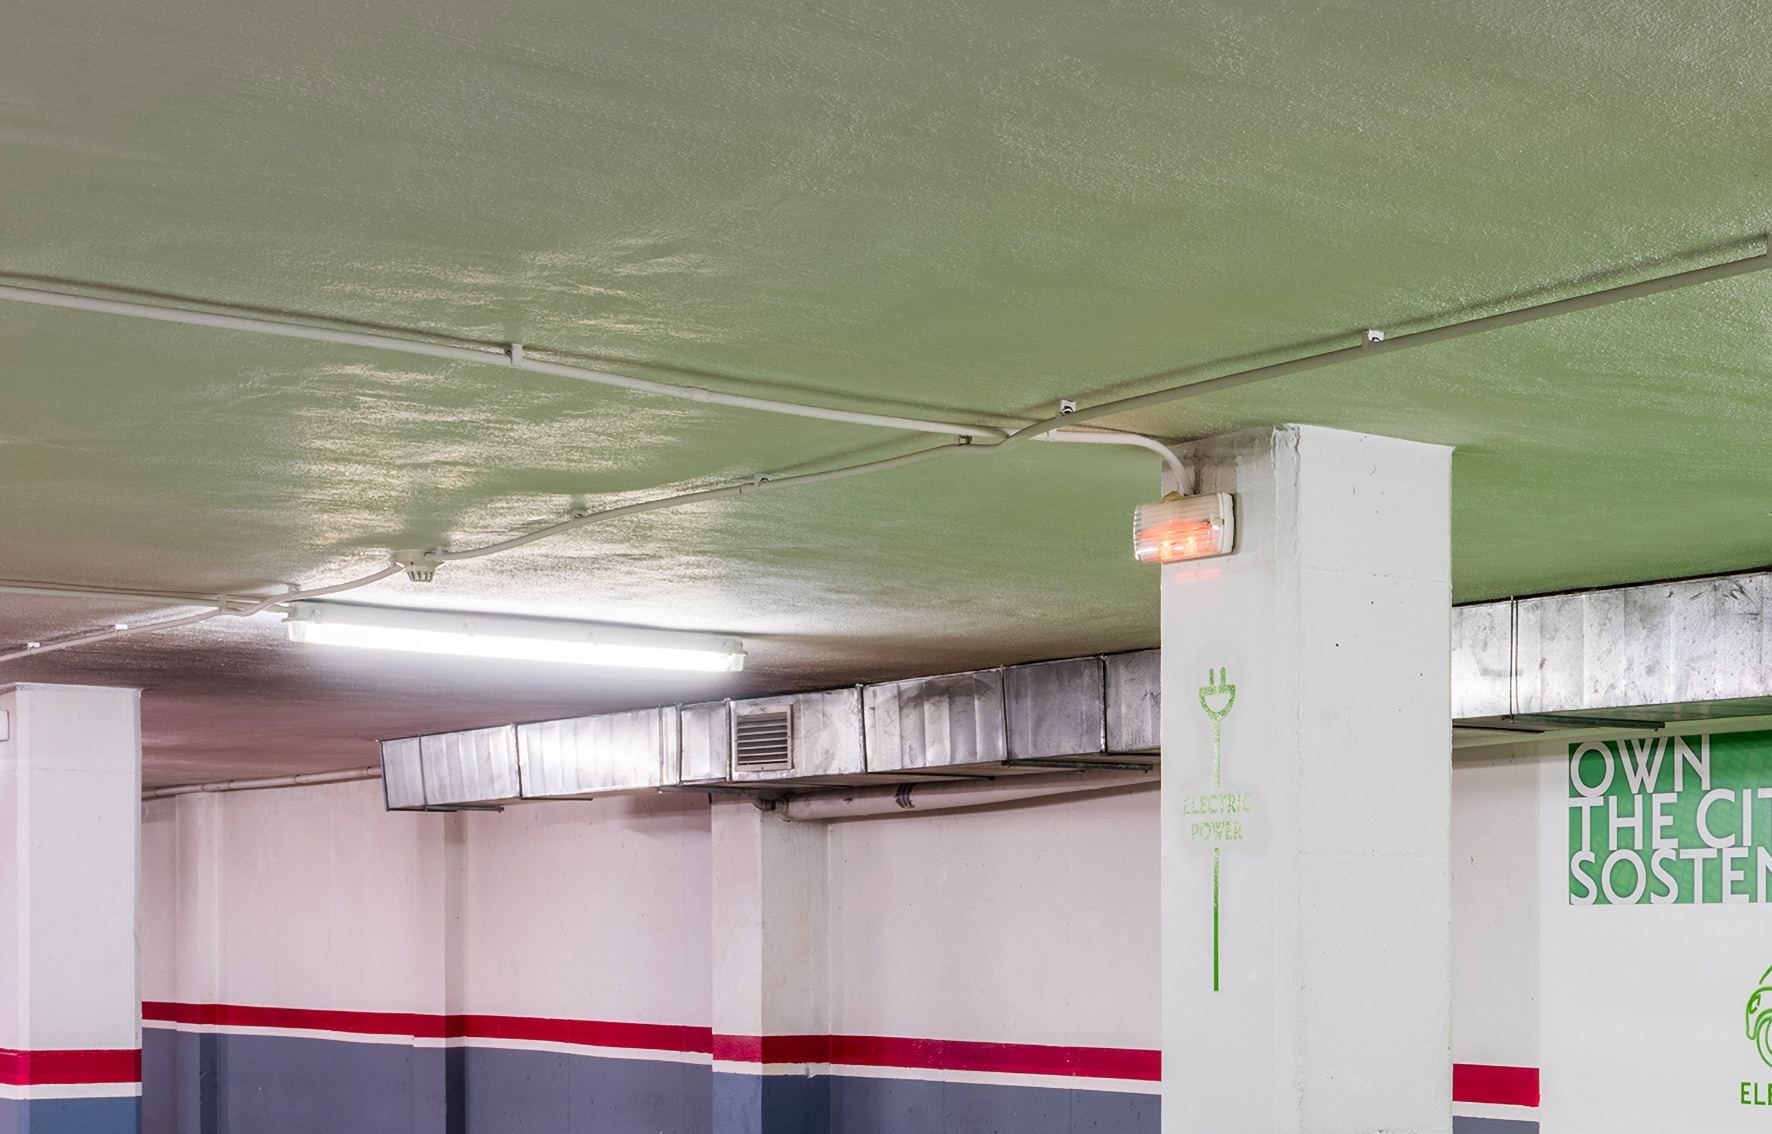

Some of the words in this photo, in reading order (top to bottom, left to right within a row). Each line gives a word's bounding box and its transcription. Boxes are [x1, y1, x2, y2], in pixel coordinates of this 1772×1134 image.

[1570, 733, 1711, 798] OWN
[1183, 792, 1252, 815] ELECTRIC
[1568, 792, 1679, 852] THE
[1191, 820, 1243, 841] POWER
